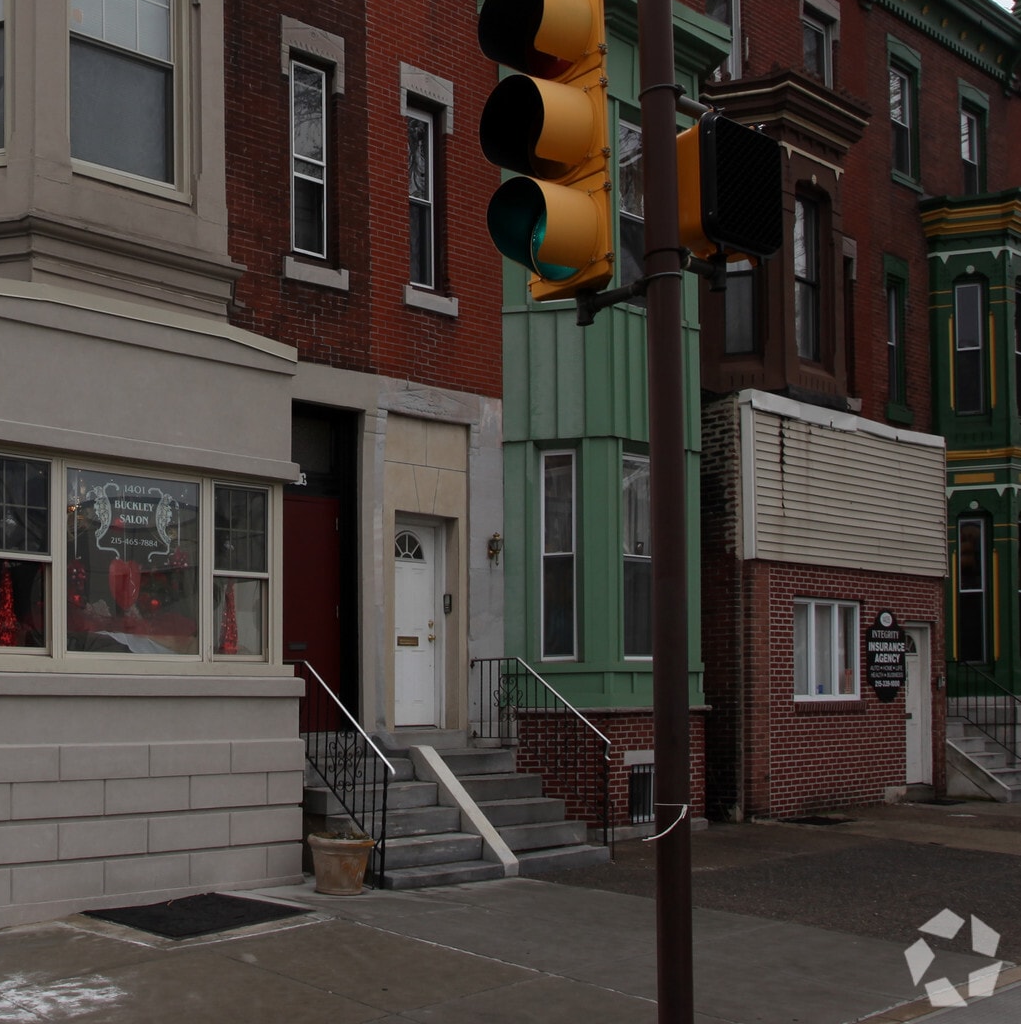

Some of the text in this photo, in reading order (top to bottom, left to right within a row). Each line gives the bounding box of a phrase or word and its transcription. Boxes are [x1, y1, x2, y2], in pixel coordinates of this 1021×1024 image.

[124, 485, 146, 495] 1401
[114, 500, 154, 512] BUCKLEY
[120, 514, 149, 525] SALON
[110, 536, 158, 547] 215-465-7884
[871, 630, 899, 639] INTEGRITY
[868, 641, 905, 652] INSURANCE
[874, 653, 901, 663] AGENCY
